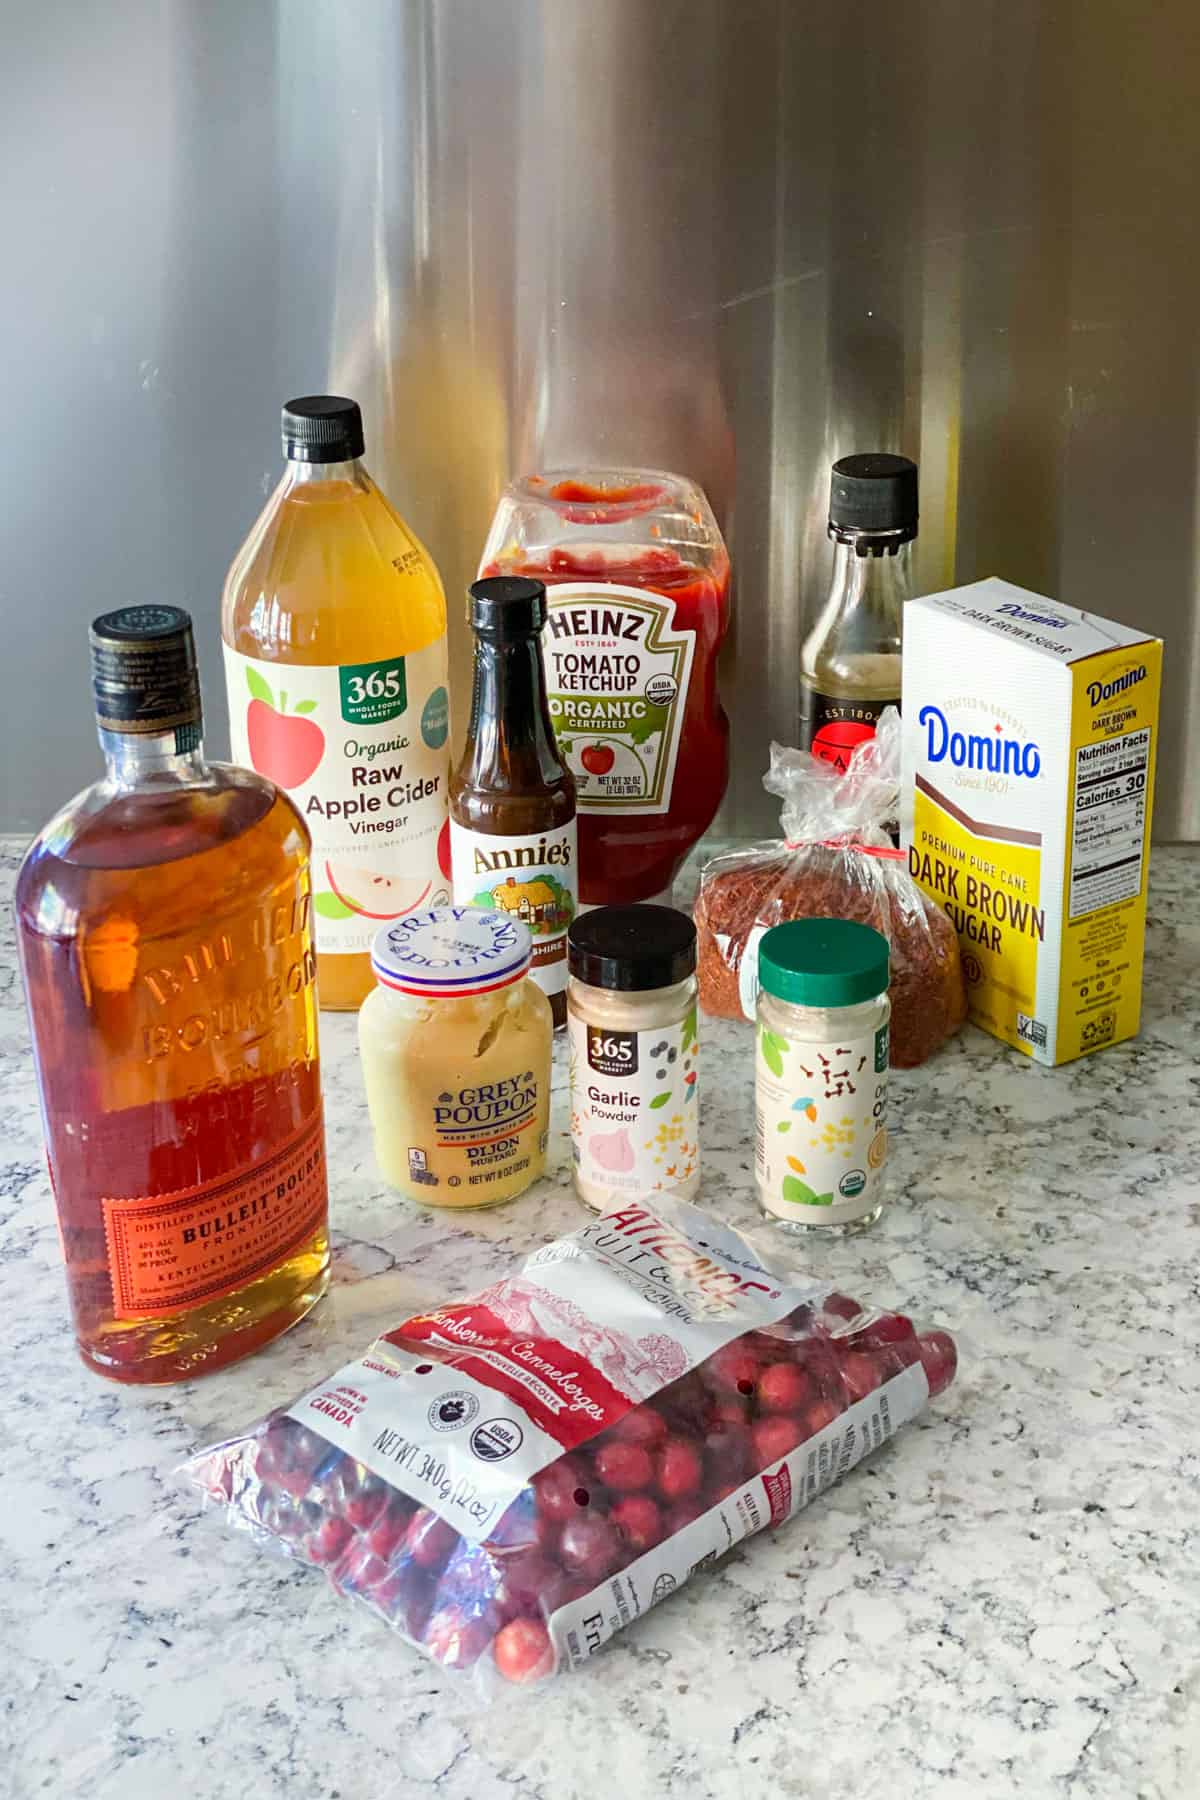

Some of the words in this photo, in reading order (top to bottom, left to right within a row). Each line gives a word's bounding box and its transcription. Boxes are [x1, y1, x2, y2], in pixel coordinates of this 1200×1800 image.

[549, 609, 645, 641] HEINZ
[995, 602, 1068, 629] Domino
[961, 608, 992, 625] DARK
[990, 618, 1036, 641] BROWN
[1030, 635, 1073, 655] SUGAR
[551, 652, 641, 675] TOMATO
[347, 669, 401, 704] 365
[558, 674, 637, 691] KETCHUP
[1086, 665, 1147, 708] Domino
[348, 704, 376, 714] WHOLE
[377, 700, 401, 710] FOODS
[361, 709, 391, 719] MARKET
[549, 699, 648, 719] ORGANIC
[824, 708, 845, 719] EST
[1091, 715, 1112, 731] DARK
[1112, 709, 1137, 726] BROWN
[568, 719, 627, 729] CERTIFIED
[343, 735, 410, 763] Organic
[918, 705, 1041, 778] Domino
[1078, 742, 1121, 762] Nutrition
[1122, 733, 1148, 749] Facts
[351, 764, 403, 787] Raw
[306, 793, 382, 820] Apple
[387, 775, 440, 808] Cider
[1076, 787, 1121, 808] Calories
[1126, 773, 1146, 792] 30
[349, 815, 409, 835] Vinegar
[472, 837, 571, 875] Annie's
[922, 831, 966, 864] PREMIUM
[969, 855, 996, 879] PURE
[1000, 870, 1028, 894] CANE
[908, 844, 960, 900] DARK
[966, 876, 1045, 942] BROWN
[387, 908, 468, 943] GREY
[943, 901, 1003, 955] SUGAR
[591, 1036, 633, 1062] 365
[433, 1082, 538, 1125] POUPON
[459, 1073, 523, 1106] GREY
[588, 1086, 641, 1107] Garlic
[591, 1105, 638, 1123] Powder
[466, 1135, 520, 1159] DIJON
[471, 1148, 517, 1167] MUSTARD
[469, 1174, 483, 1186] NET
[484, 1172, 497, 1184] WT
[136, 1213, 195, 1233] DISTILLED
[181, 1193, 269, 1246] BULLEIT
[202, 1204, 281, 1250] FRONTIER
[157, 1255, 226, 1282] KENTUCKY
[511, 1340, 604, 1422] Canneberges
[309, 1397, 354, 1429] CANADA
[490, 1423, 516, 1445] USDA
[373, 1427, 402, 1456] NET
[416, 1454, 452, 1500] 340g
